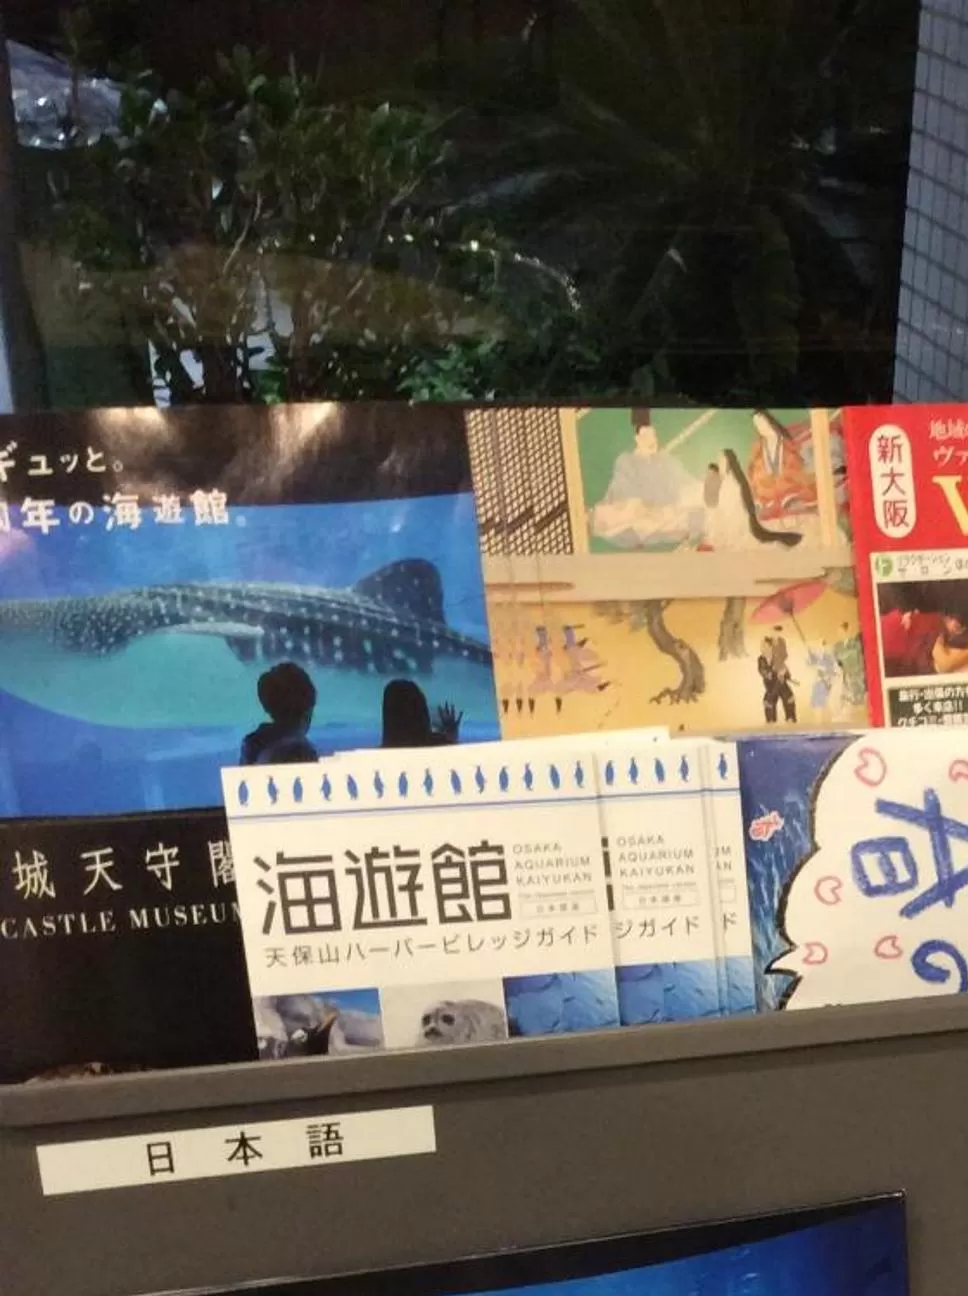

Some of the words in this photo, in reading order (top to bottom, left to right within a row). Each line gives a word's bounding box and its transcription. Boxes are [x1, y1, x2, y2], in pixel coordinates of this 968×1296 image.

[877, 434, 910, 529] 新大阪
[512, 842, 563, 855] OSAKA
[616, 834, 665, 848] OSAKA
[514, 855, 591, 871] AQUARIUM
[618, 848, 694, 863] AQUARIUM
[515, 871, 593, 888] KAIYUKAN
[619, 863, 695, 879] KAIYUKAN
[253, 839, 513, 936] 海遊館
[0, 912, 117, 941] CASTLE
[264, 921, 598, 968] 天保山ハーバービレッジガイド
[145, 1121, 345, 1177] 日本語
